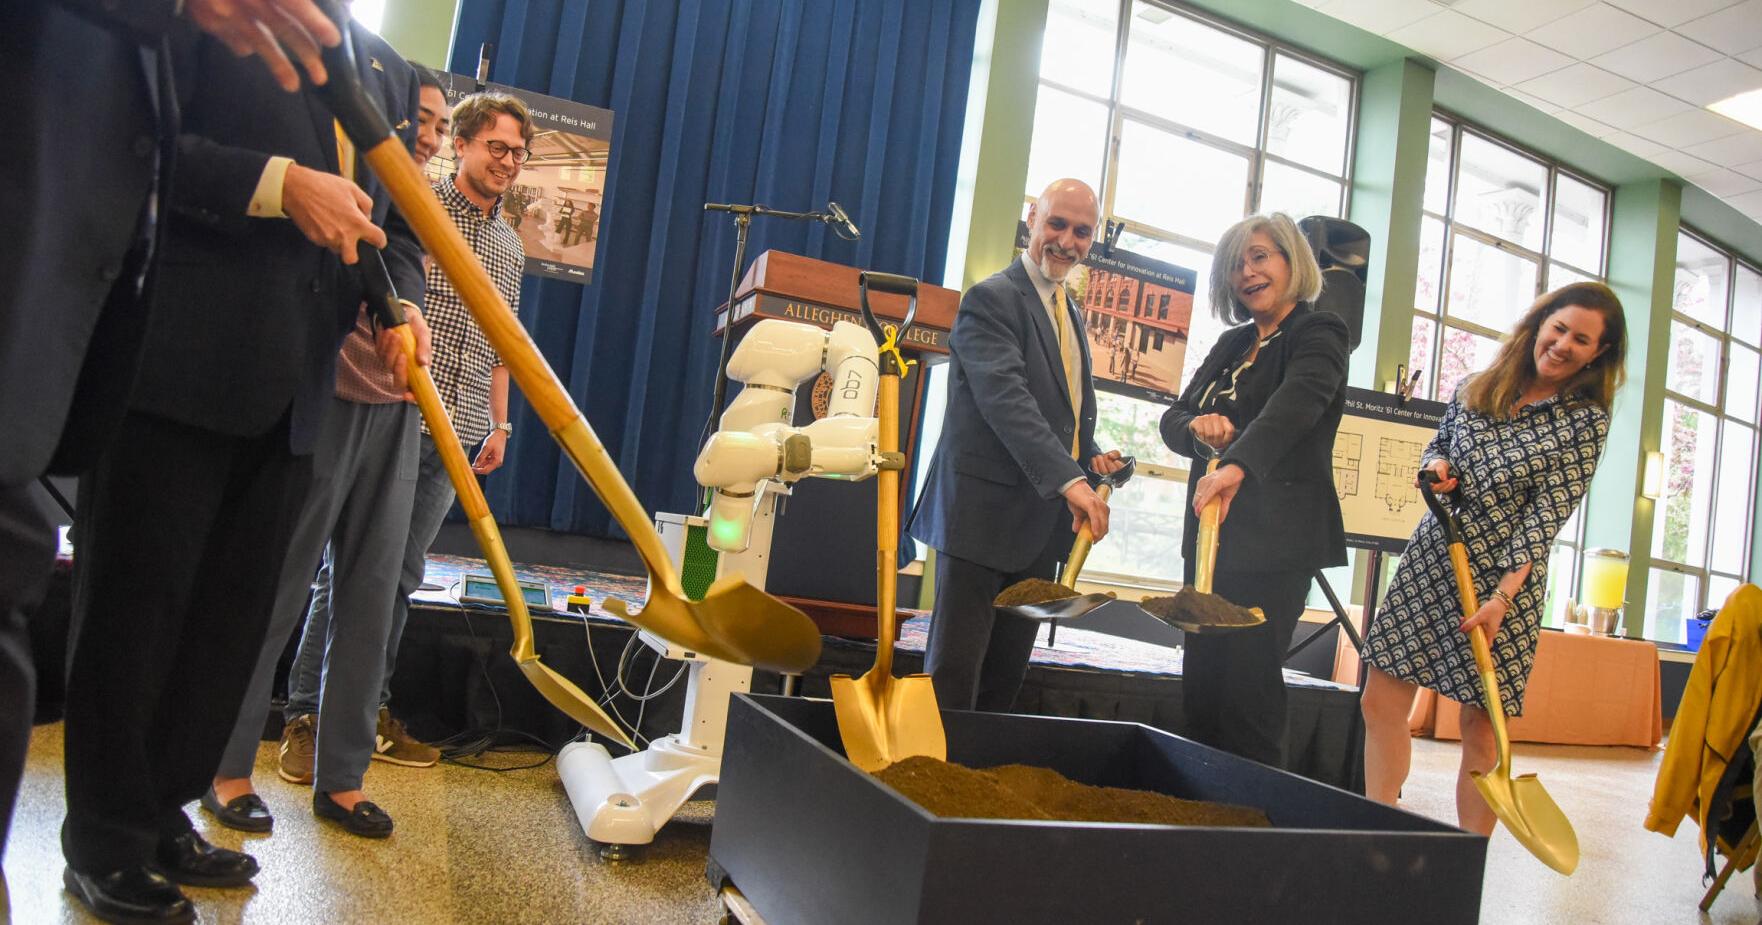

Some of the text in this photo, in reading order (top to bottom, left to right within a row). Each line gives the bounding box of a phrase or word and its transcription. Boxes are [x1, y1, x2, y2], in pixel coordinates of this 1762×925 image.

[550, 112, 559, 122] at
[560, 115, 578, 126] Reis
[580, 120, 596, 131] Hall
[784, 303, 863, 327] ALLEGHEN
[1393, 407, 1412, 418] Center
[1413, 411, 1422, 419] for
